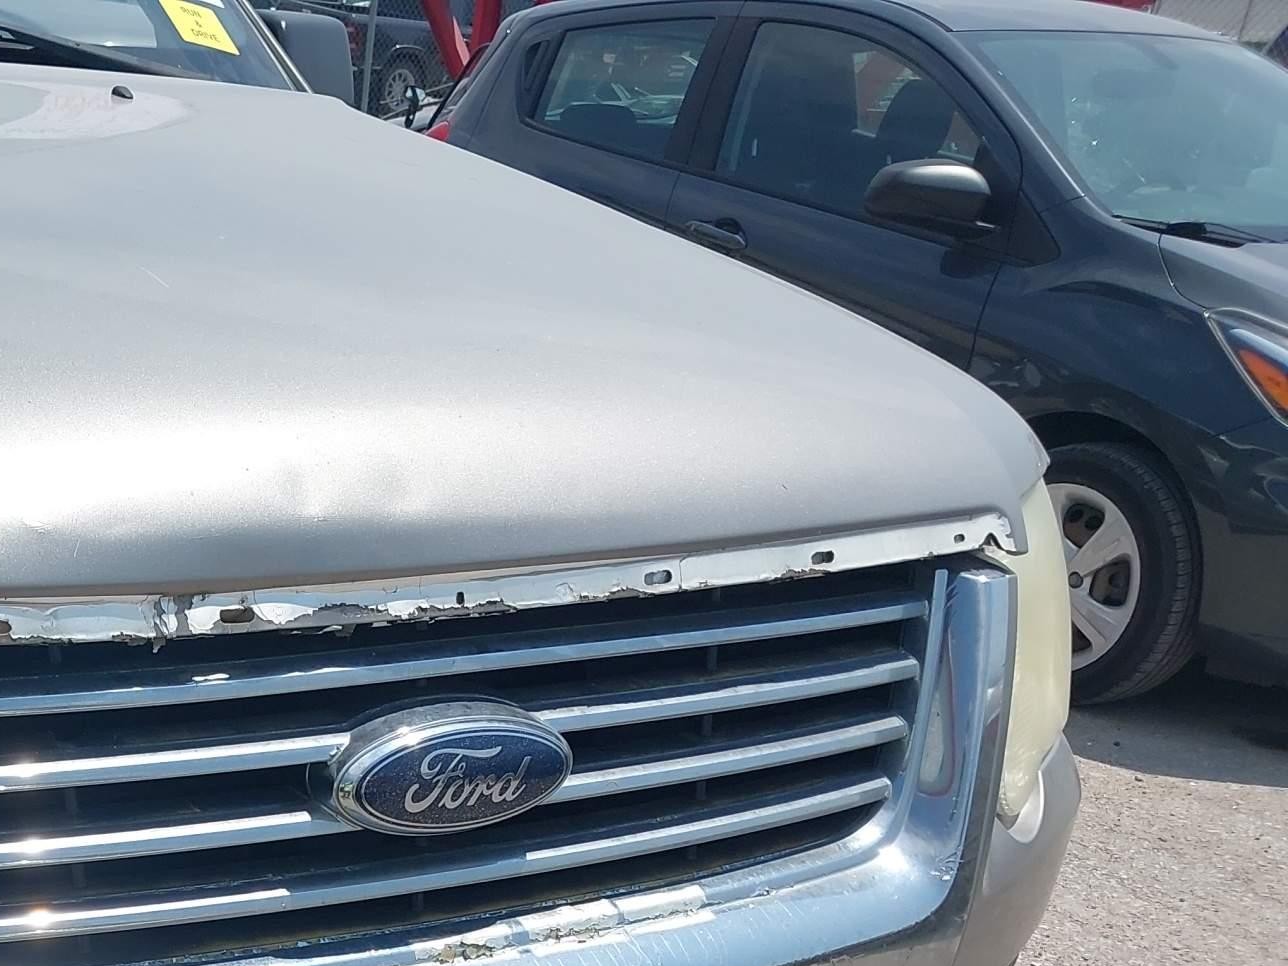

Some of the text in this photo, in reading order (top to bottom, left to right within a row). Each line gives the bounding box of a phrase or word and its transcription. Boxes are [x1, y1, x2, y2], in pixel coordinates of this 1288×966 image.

[179, 6, 202, 18] RUN
[190, 28, 221, 43] DRIVE
[404, 746, 532, 813] Ford
